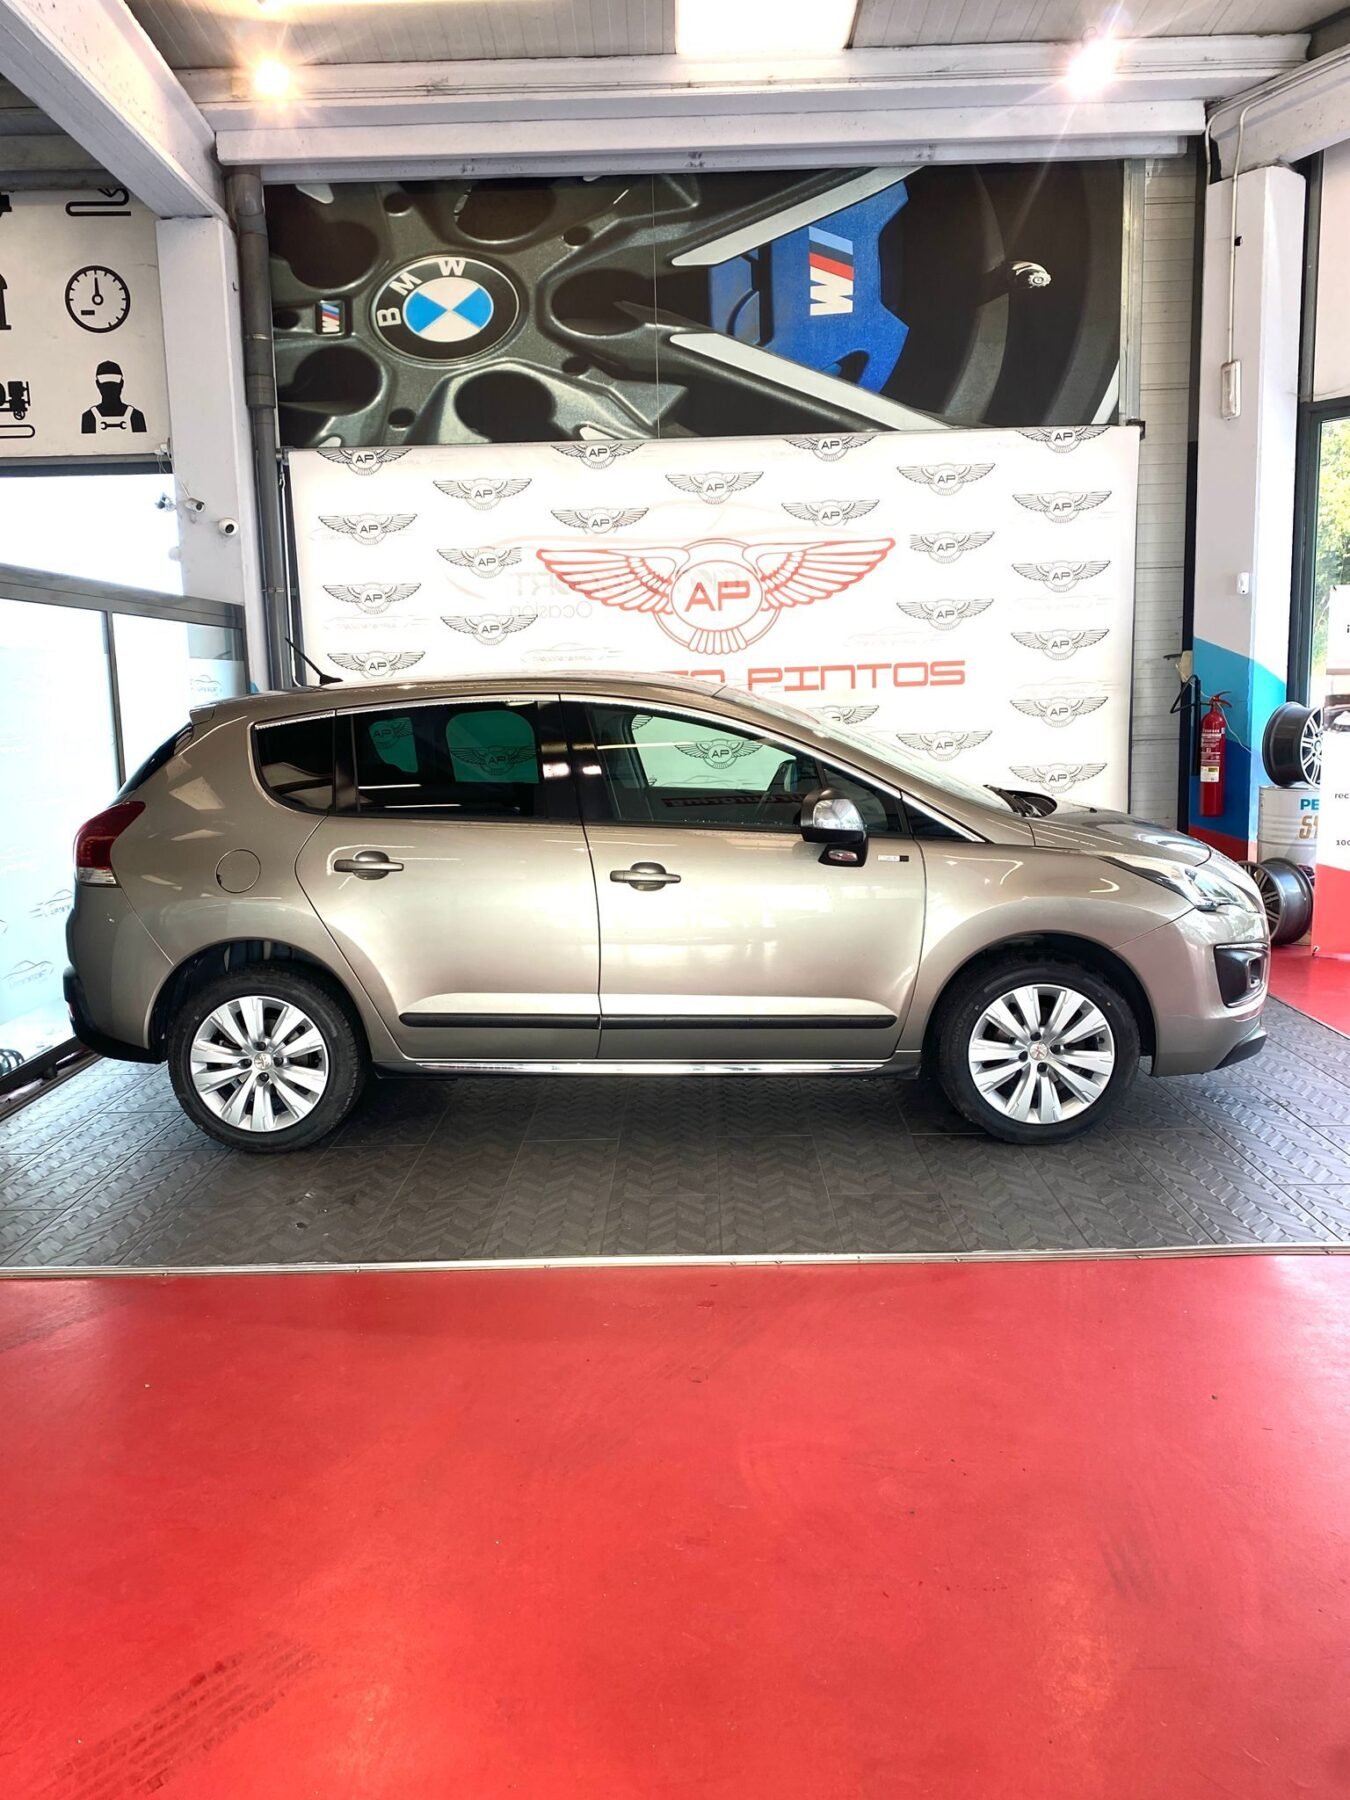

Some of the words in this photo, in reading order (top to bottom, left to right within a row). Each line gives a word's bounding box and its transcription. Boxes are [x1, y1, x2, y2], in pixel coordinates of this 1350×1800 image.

[376, 259, 467, 327] BMW
[1054, 432, 1073, 441] AP
[821, 440, 840, 449] AP
[589, 448, 607, 457] AP
[356, 454, 374, 463] AP
[937, 474, 956, 483] AP
[706, 483, 724, 491] AP
[475, 489, 493, 497] AP
[1053, 503, 1072, 511] AP
[822, 511, 840, 519] AP
[592, 519, 609, 527] AP
[360, 525, 378, 533] AP
[937, 543, 955, 551] AP
[478, 558, 496, 566] AP
[1052, 572, 1070, 580] AP
[364, 594, 382, 602] AP
[684, 580, 750, 612] AP
[936, 610, 955, 618] AP
[482, 625, 499, 633] AP
[1051, 640, 1069, 648] AP
[368, 662, 387, 670] AP
[748, 660, 965, 691] PINTOS
[1050, 707, 1068, 715] AP
[936, 742, 953, 750] AP
[711, 750, 729, 758] AP
[1048, 774, 1067, 782] AP
